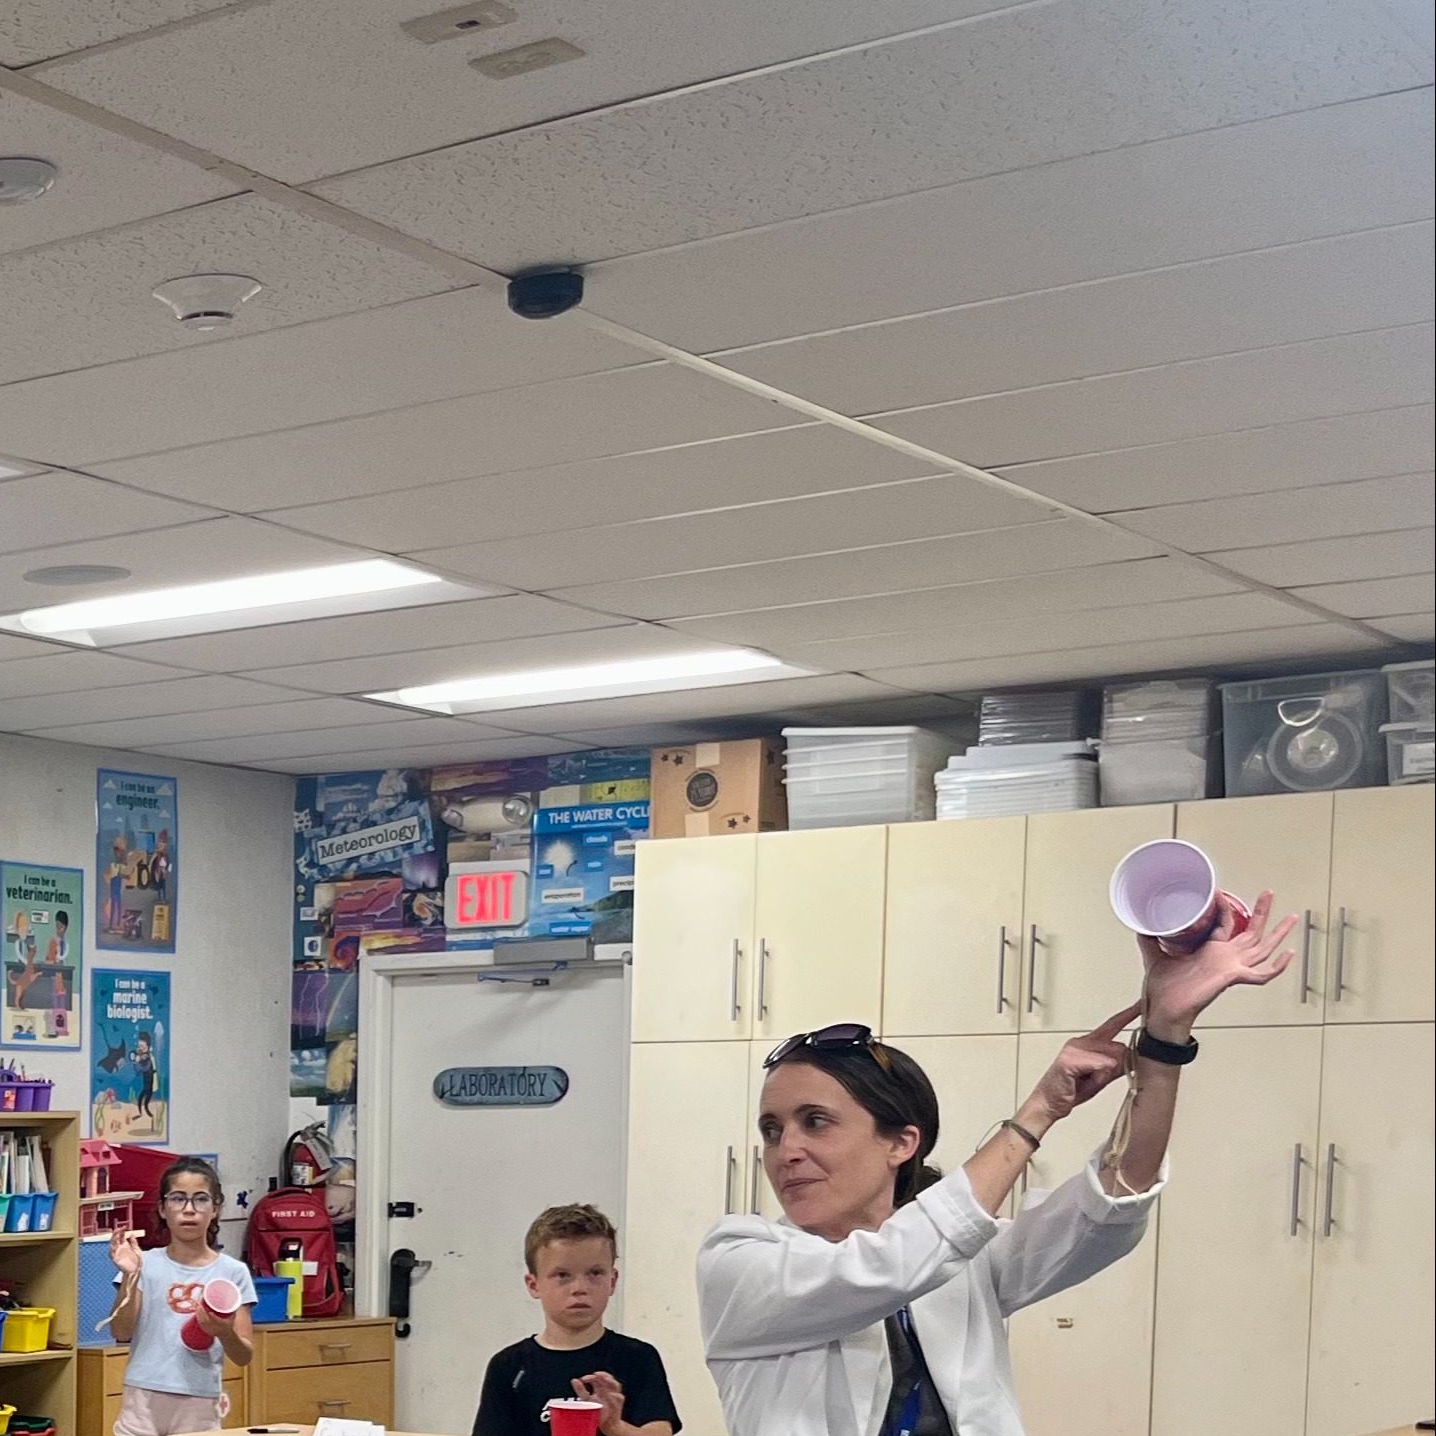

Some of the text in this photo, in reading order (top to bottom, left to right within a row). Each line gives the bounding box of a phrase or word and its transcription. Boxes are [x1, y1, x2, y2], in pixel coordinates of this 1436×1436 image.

[116, 792, 161, 811] engineer.
[548, 811, 571, 825] THE
[572, 807, 613, 823] WATER
[319, 824, 417, 859] Meteorology
[28, 876, 41, 886] can
[41, 876, 50, 887] be
[6, 885, 73, 905] veterinarian.
[457, 871, 516, 925] EXIT
[118, 980, 131, 989] can
[132, 979, 140, 990] be
[113, 990, 147, 1005] marine
[107, 1004, 154, 1024] biologist.
[449, 1073, 547, 1097] LABORATORY
[272, 1210, 316, 1218] FIRST AID
